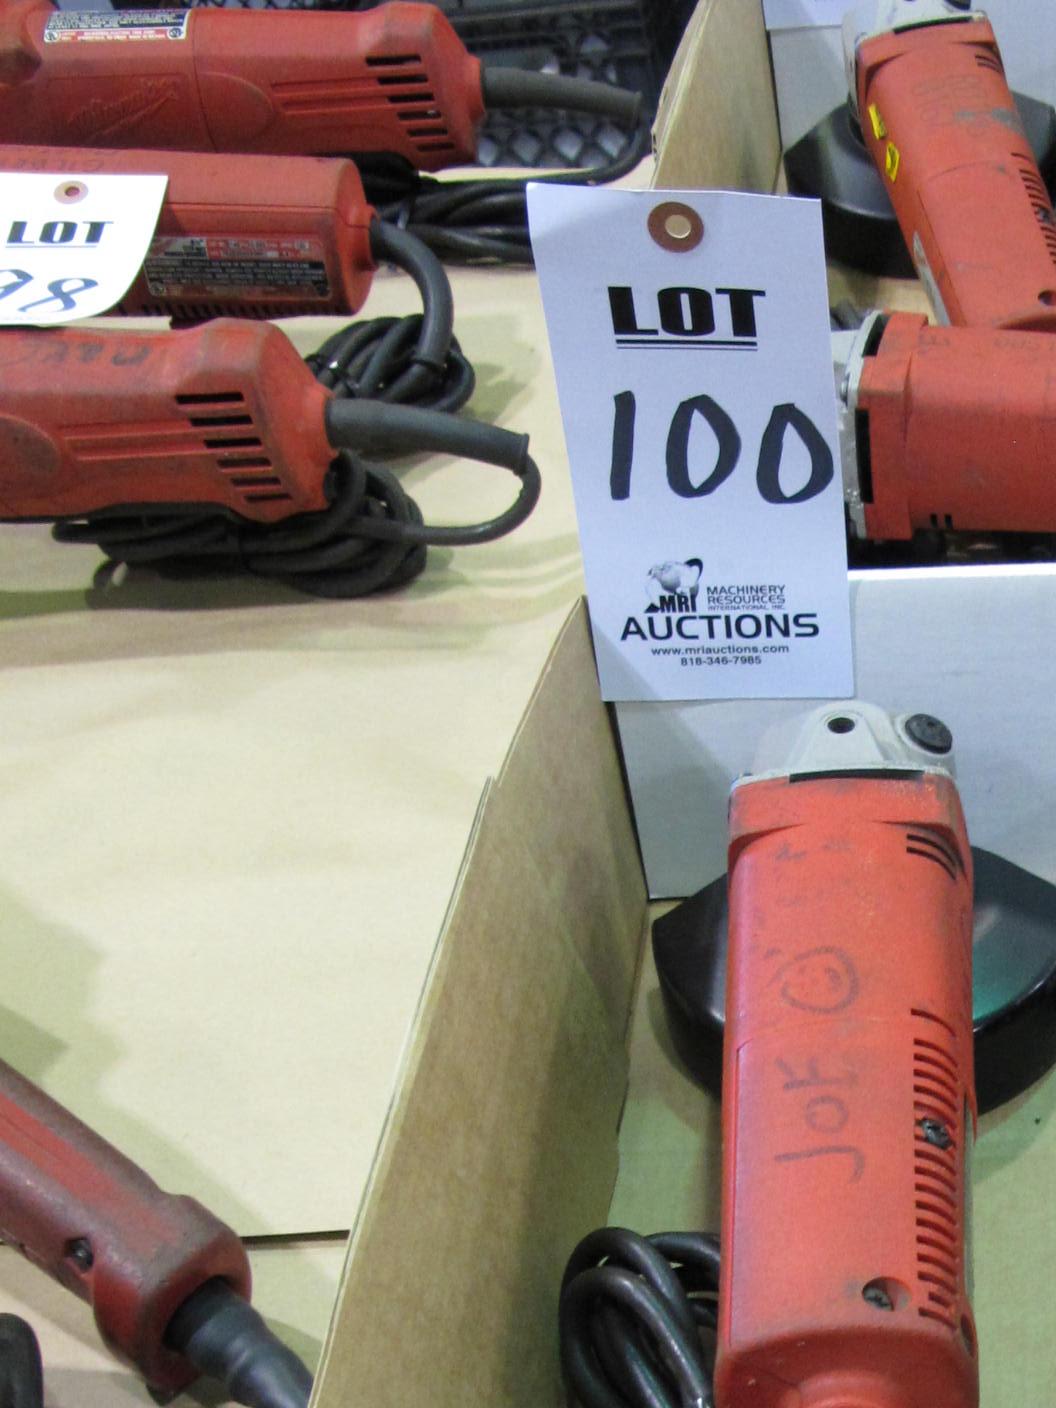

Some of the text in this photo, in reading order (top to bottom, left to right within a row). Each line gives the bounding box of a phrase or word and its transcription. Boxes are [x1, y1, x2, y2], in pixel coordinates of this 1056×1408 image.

[7, 221, 114, 244] LOT
[607, 286, 766, 337] LOT
[610, 390, 834, 504] 100
[706, 584, 786, 595] MACHINERY
[707, 595, 786, 605] RESOURCES
[659, 593, 697, 613] MRI
[620, 613, 820, 641] AUCTIONS
[651, 644, 790, 656] www.mriauctions.com
